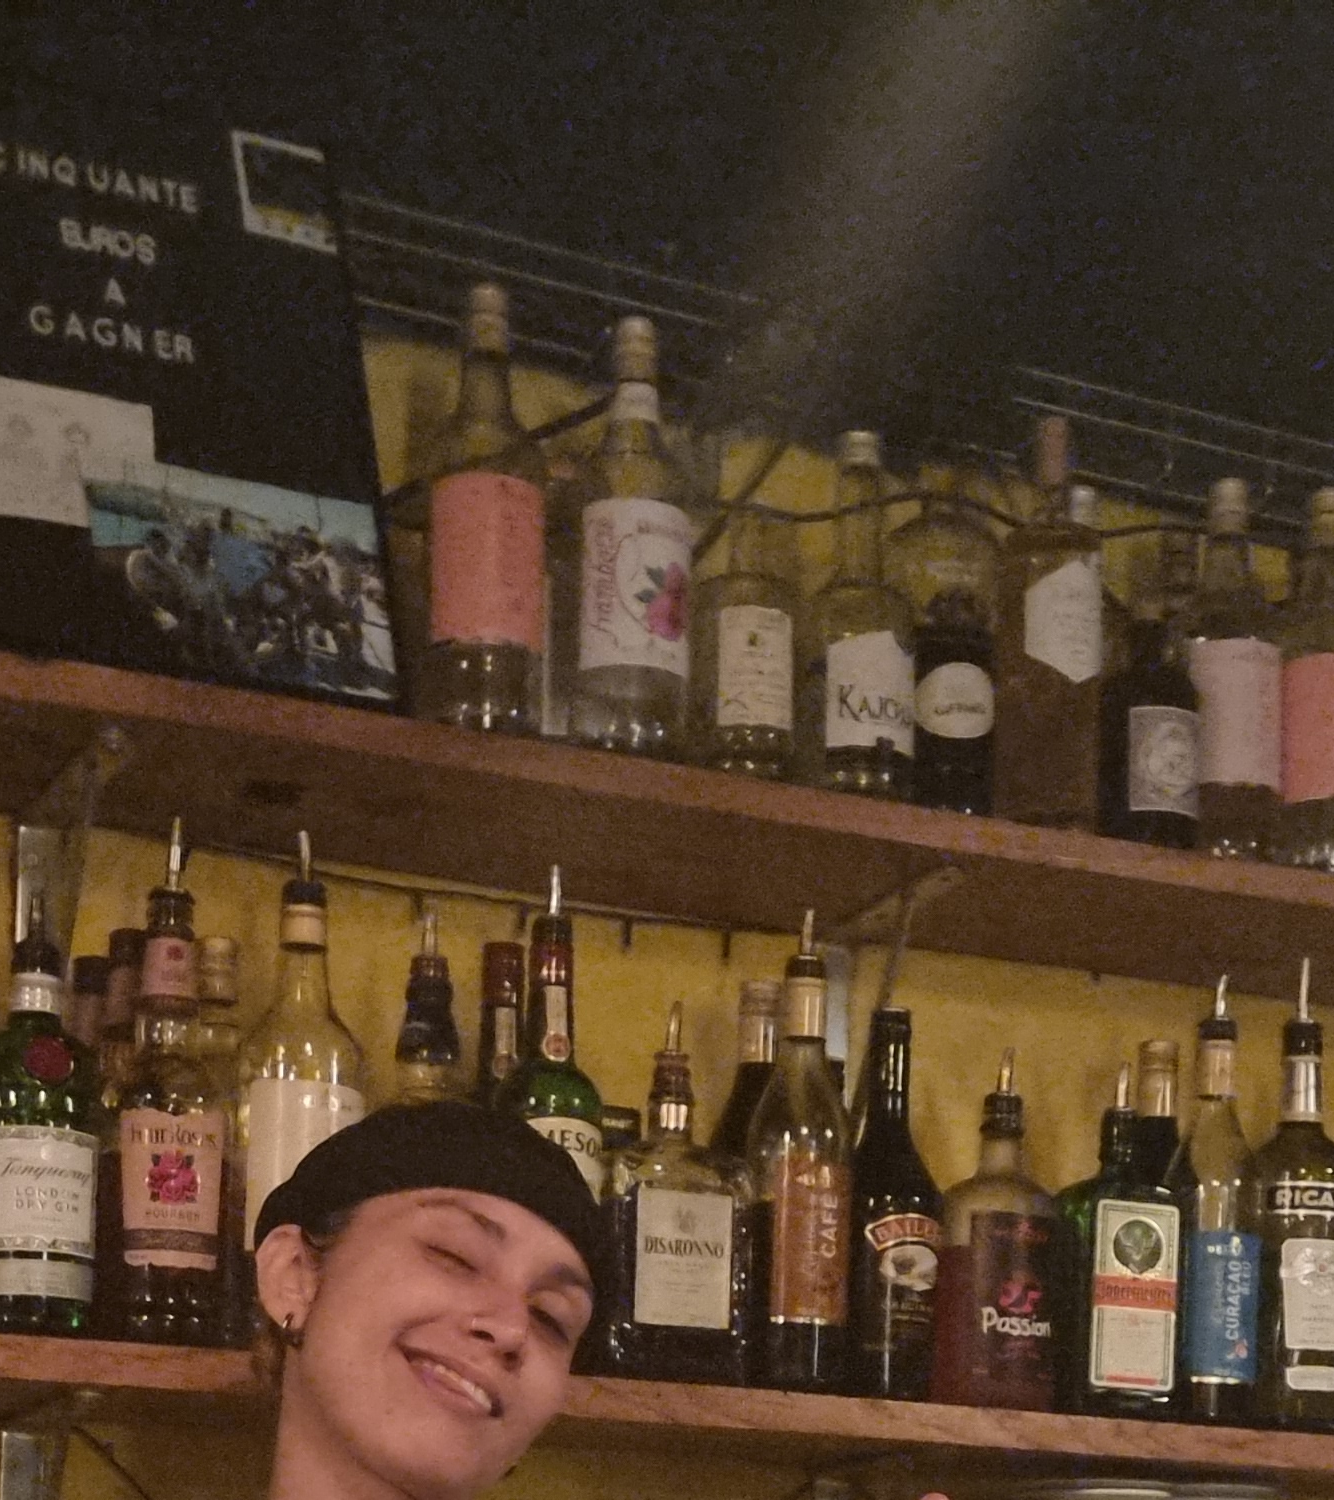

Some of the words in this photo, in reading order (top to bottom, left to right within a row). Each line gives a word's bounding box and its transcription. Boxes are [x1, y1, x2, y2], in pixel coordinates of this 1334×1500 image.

[59, 217, 157, 266] EUROS
[104, 277, 127, 305] A
[28, 304, 195, 365] GAGNER
[644, 1234, 724, 1259] DISARONNO
[981, 1306, 1051, 1337] Passion
